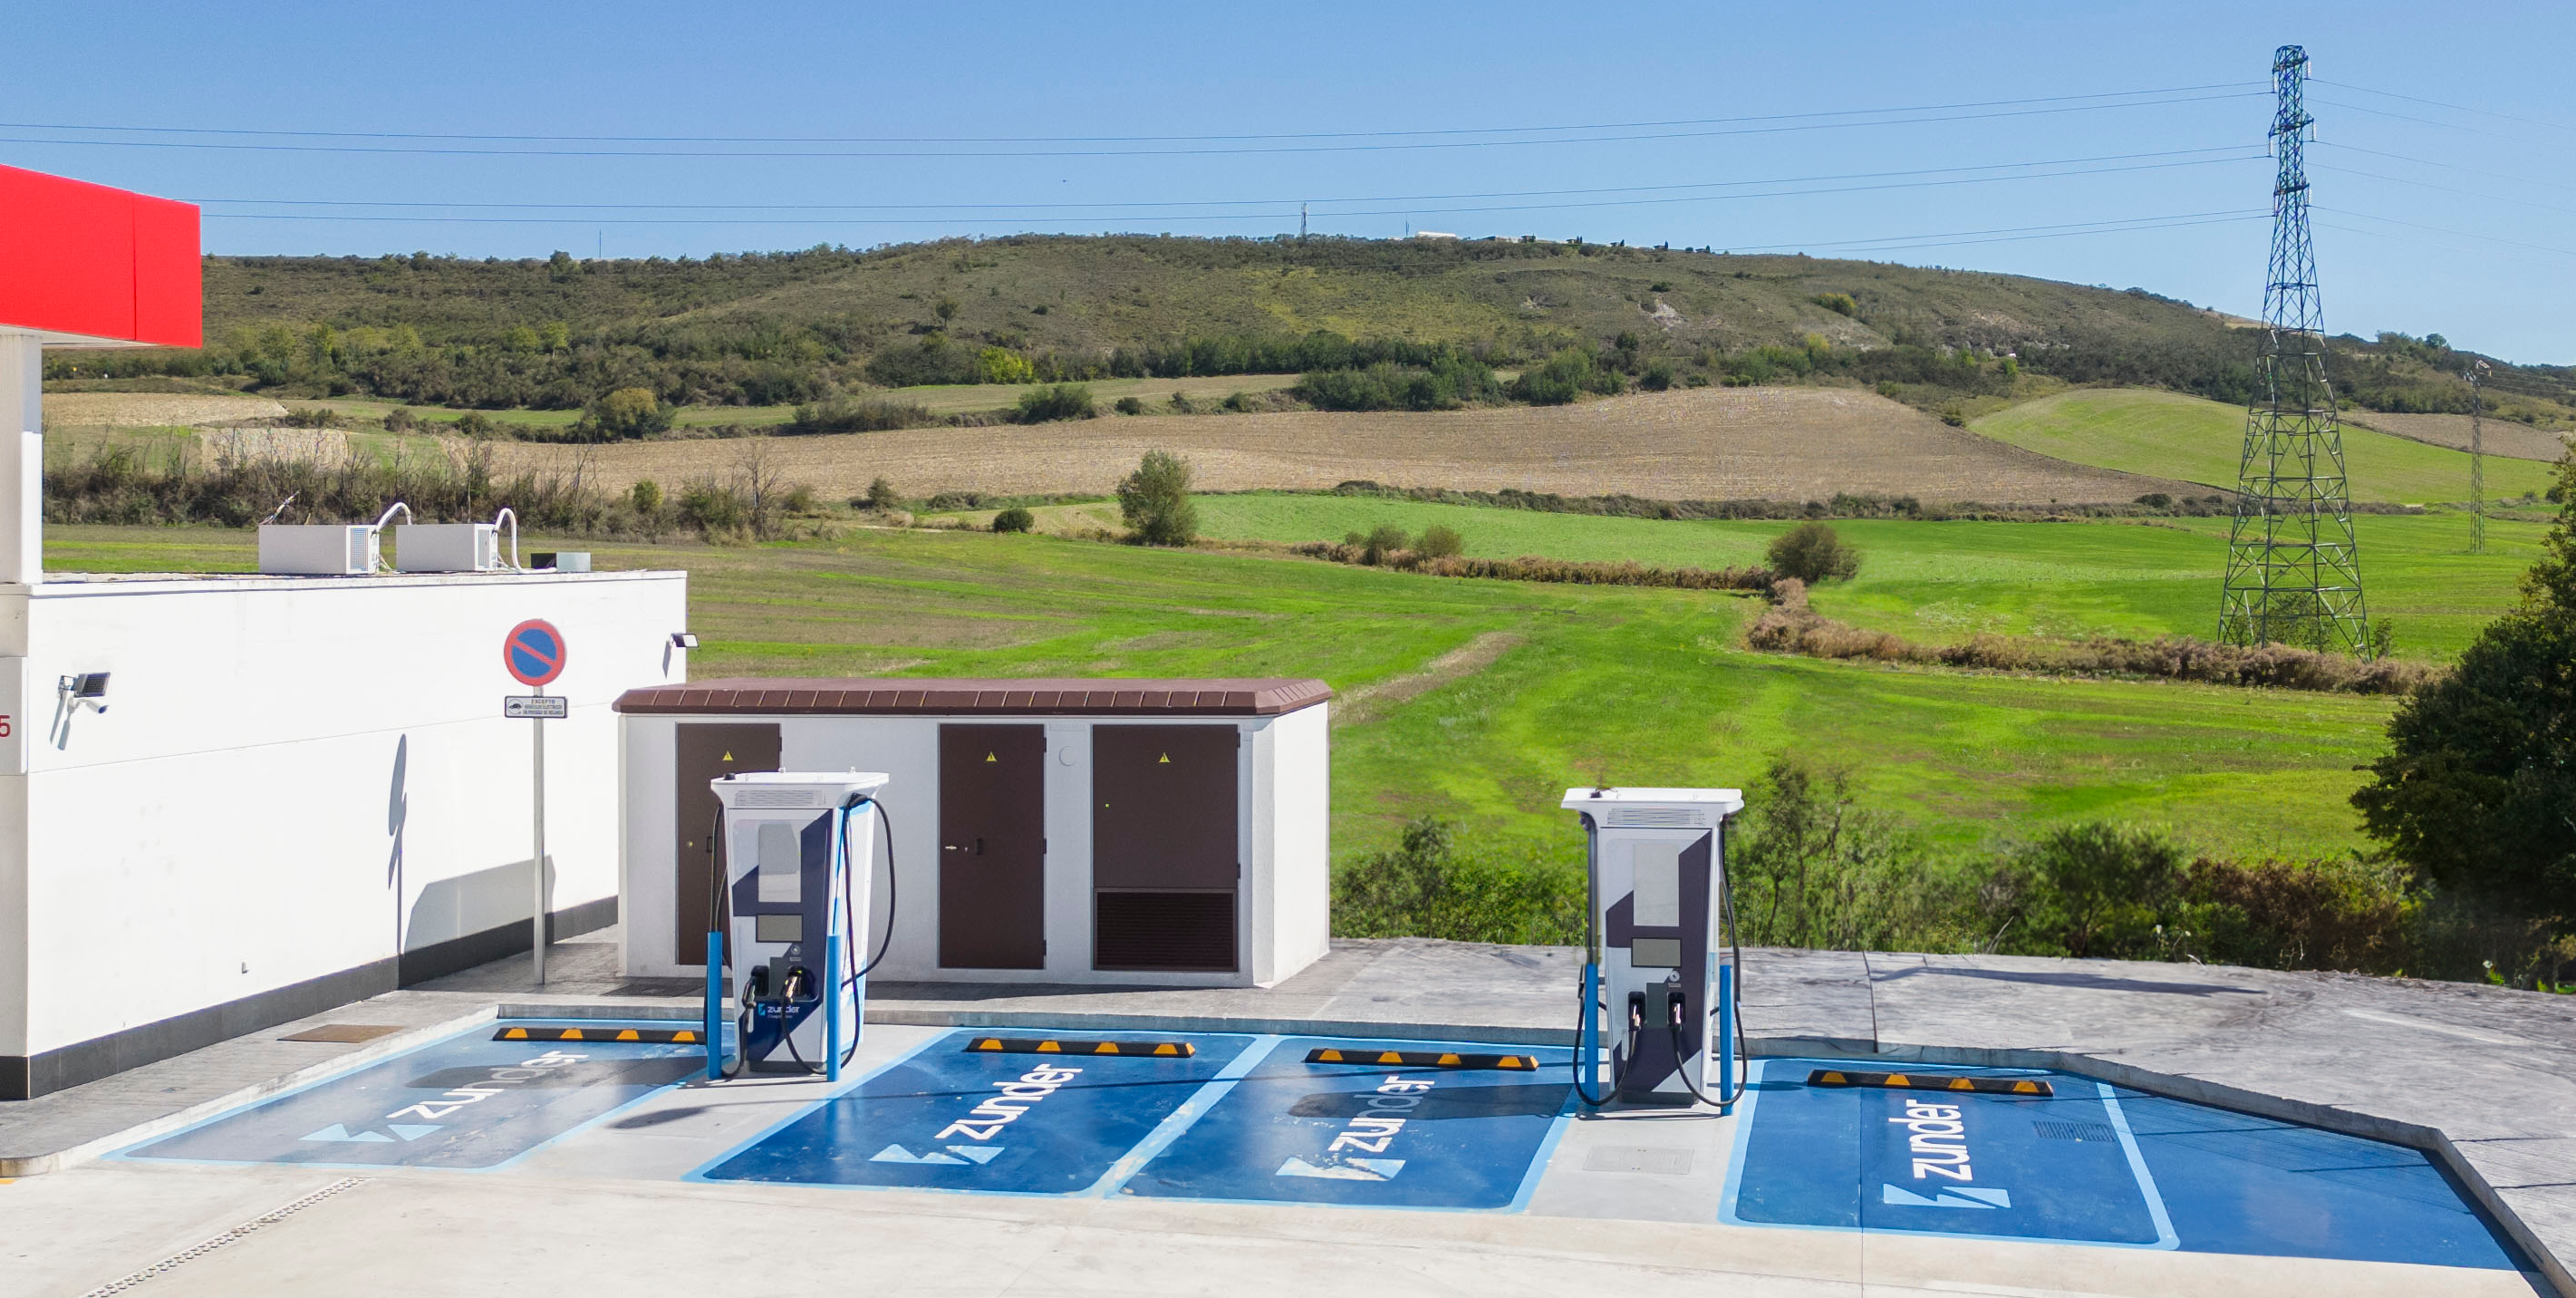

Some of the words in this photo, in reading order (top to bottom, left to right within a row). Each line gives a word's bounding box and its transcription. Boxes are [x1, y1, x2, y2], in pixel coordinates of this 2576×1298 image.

[385, 1051, 589, 1119] zunder
[934, 1063, 1084, 1140] zunder
[1327, 1076, 1435, 1153] zunder
[1888, 1099, 1973, 1181] zunder
